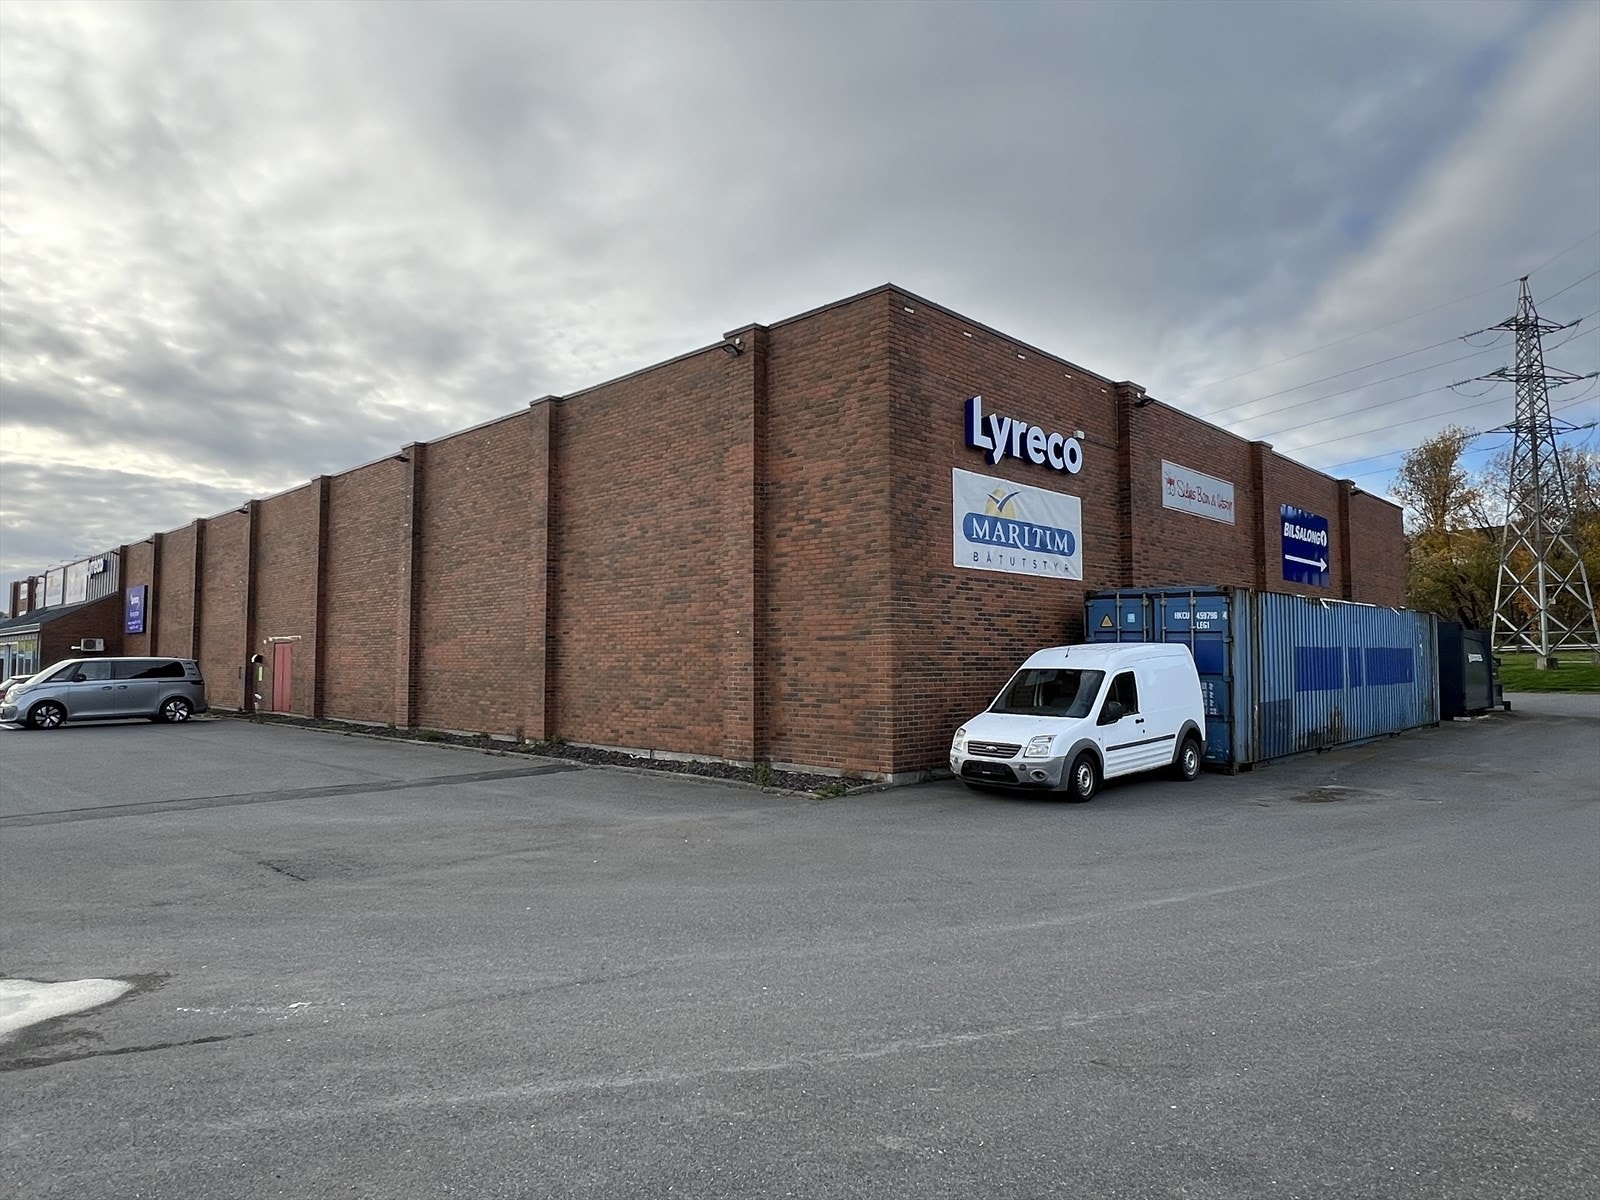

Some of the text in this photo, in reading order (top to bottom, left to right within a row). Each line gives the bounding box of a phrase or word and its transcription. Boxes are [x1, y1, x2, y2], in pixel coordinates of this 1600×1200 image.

[968, 395, 1083, 474] Lyreco
[972, 517, 1069, 553] MARITIM
[973, 551, 1070, 573] BÅTUTSTYR
[1174, 611, 1228, 620] HKCU 459796 4
[1196, 621, 1210, 629] LEG1
